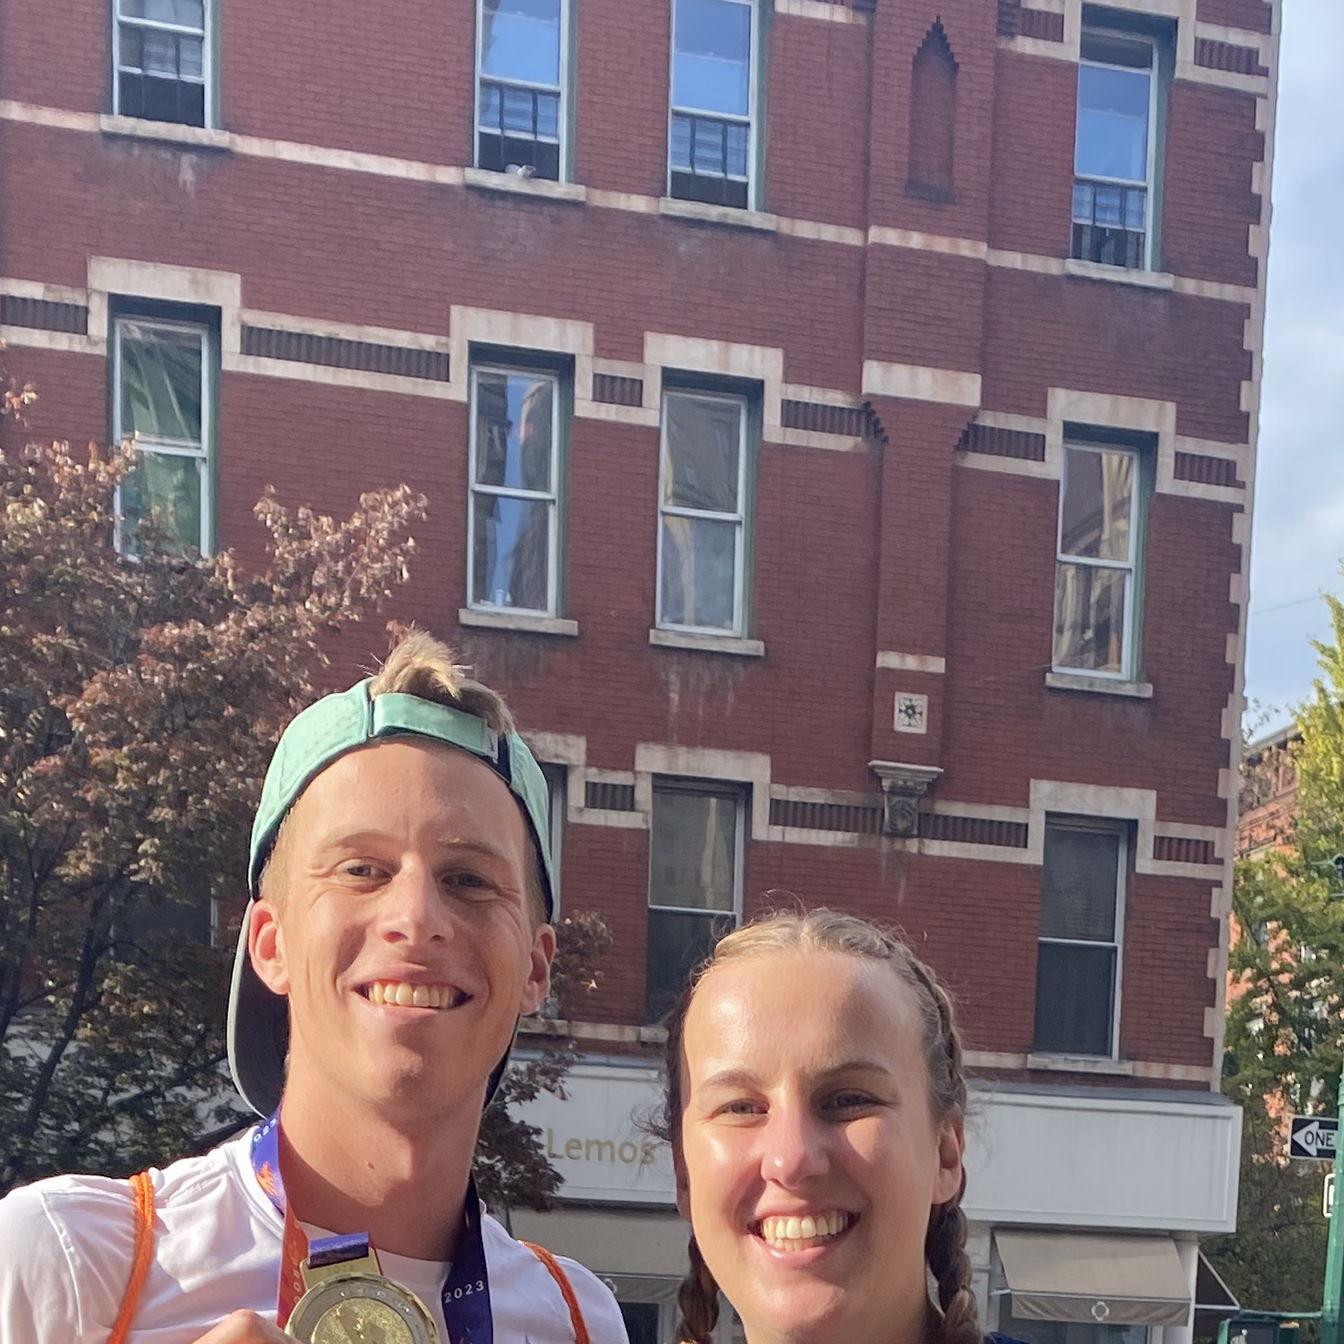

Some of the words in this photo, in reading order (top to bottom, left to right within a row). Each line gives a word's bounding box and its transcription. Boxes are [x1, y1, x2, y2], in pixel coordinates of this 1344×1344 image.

[546, 1127, 655, 1165] Lemos
[1304, 1130, 1335, 1147] ONE
[443, 1279, 485, 1304] 2023
